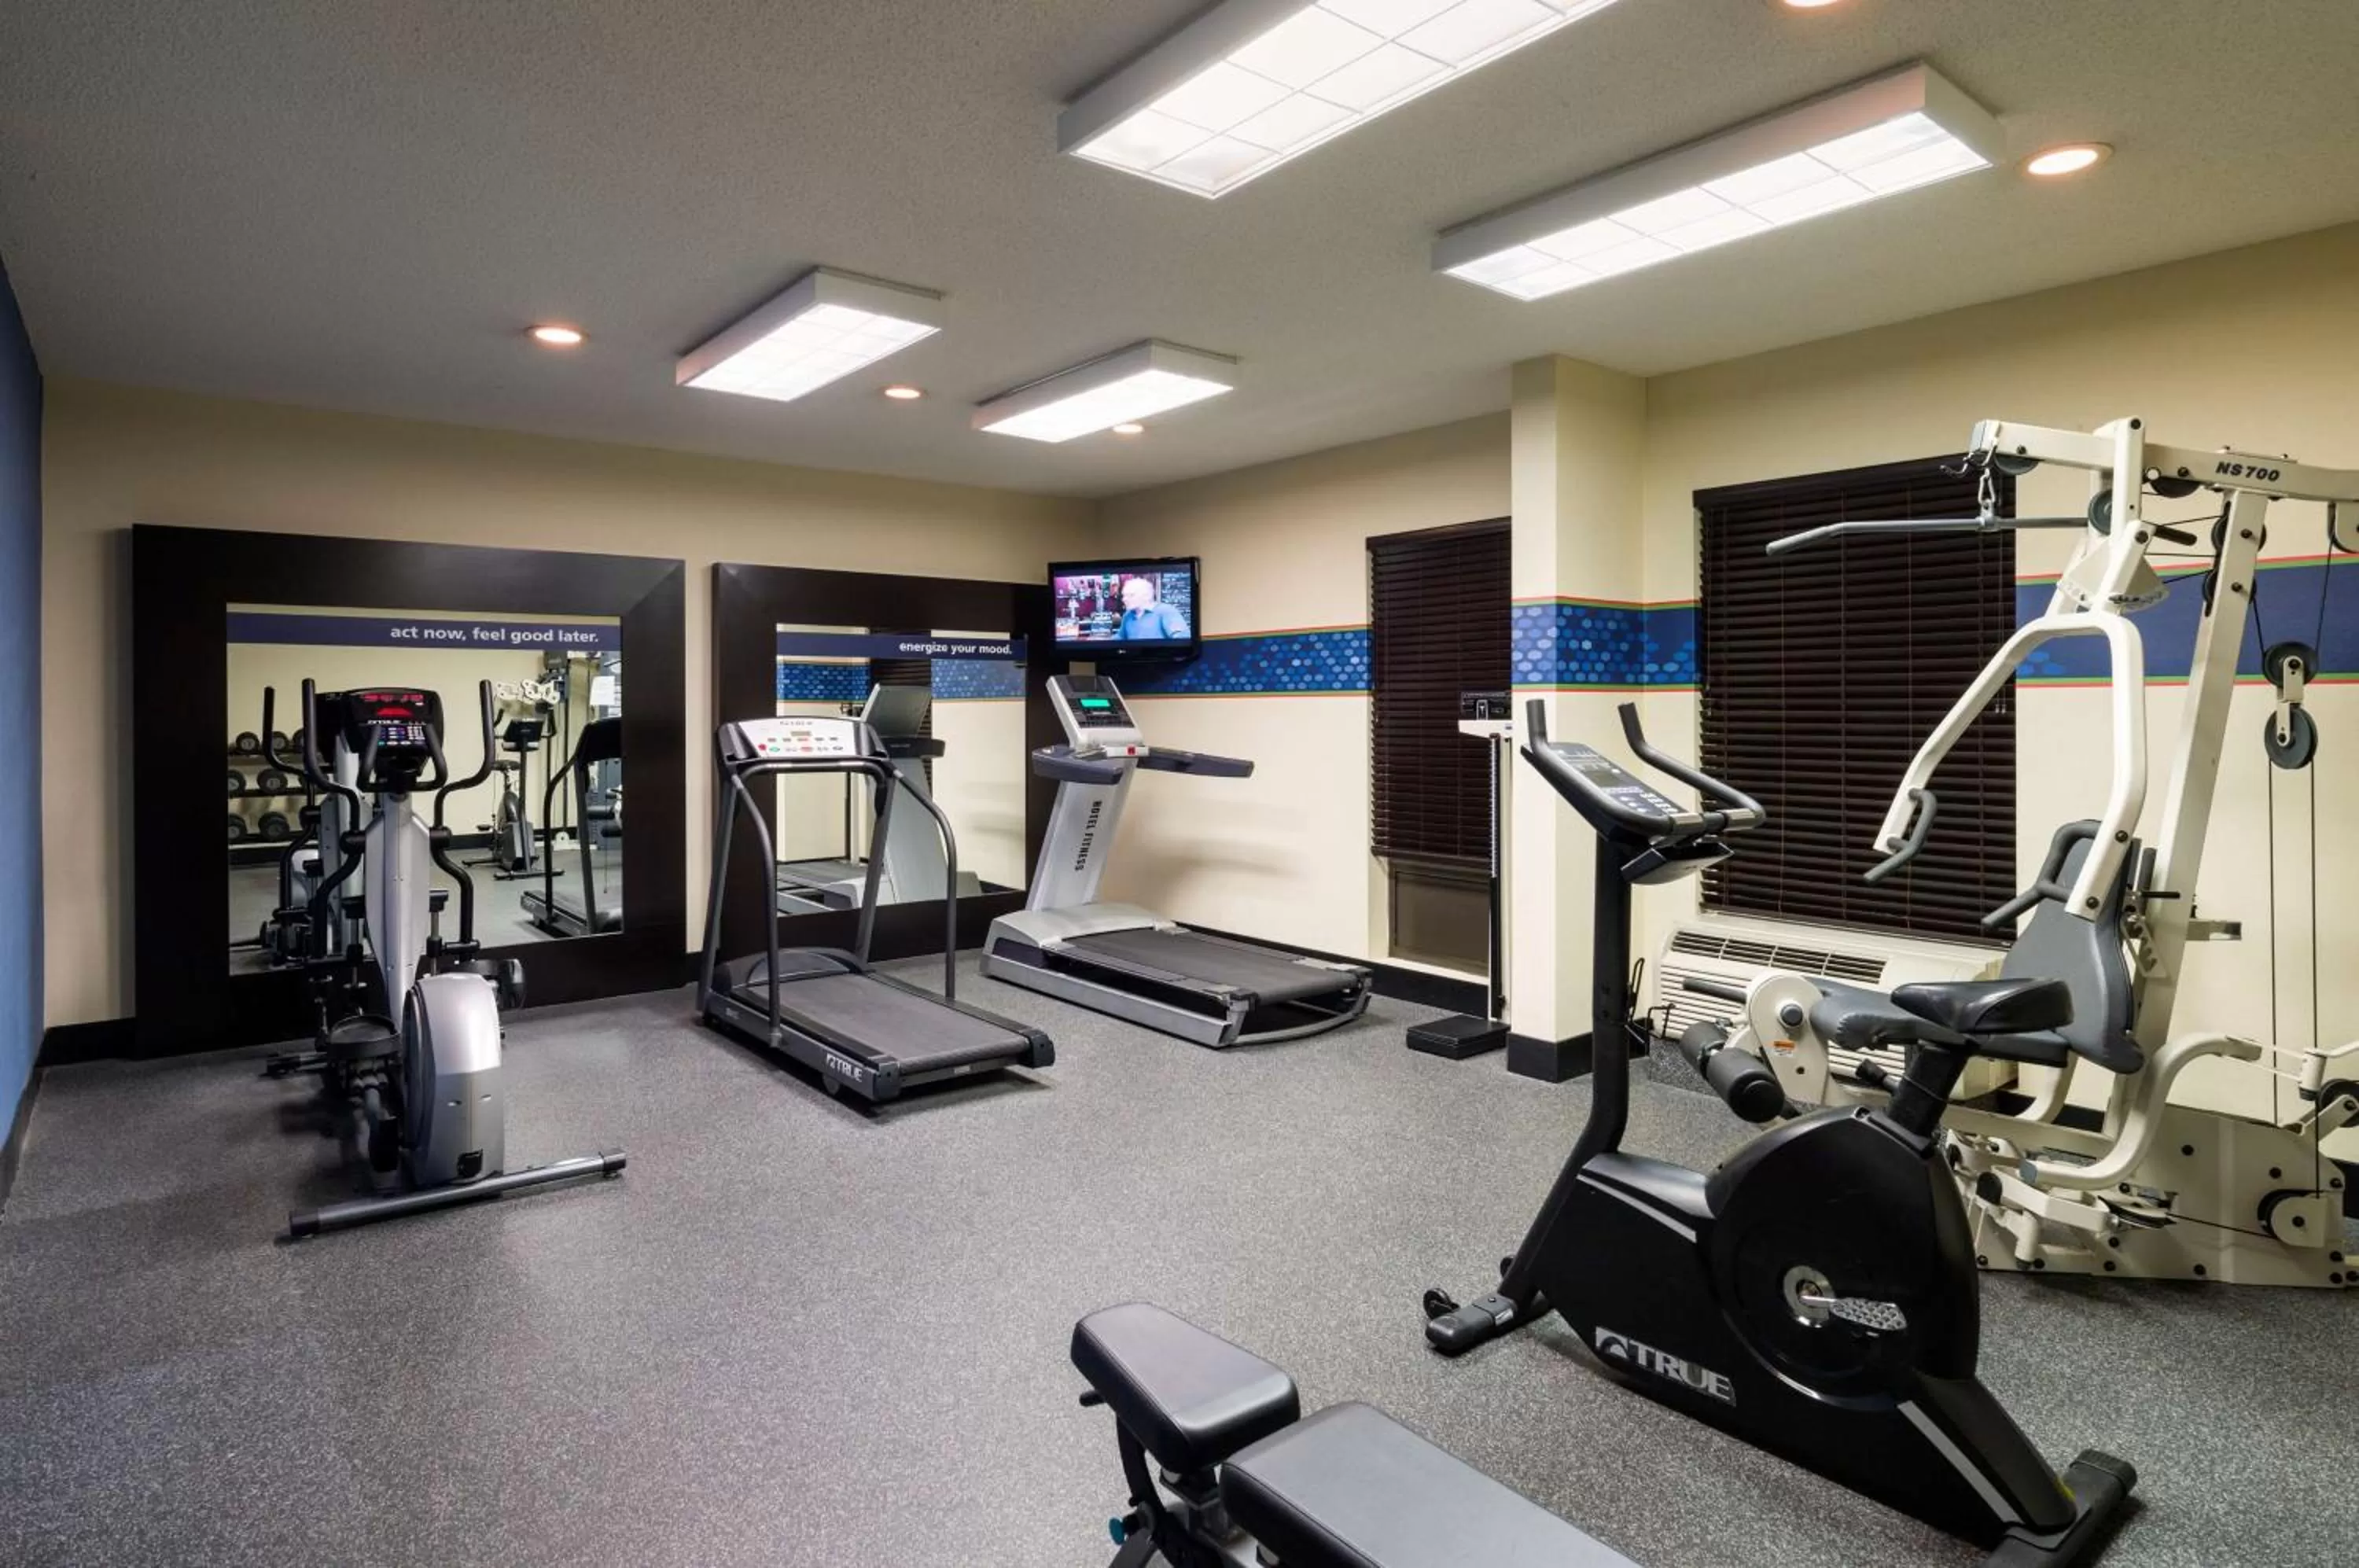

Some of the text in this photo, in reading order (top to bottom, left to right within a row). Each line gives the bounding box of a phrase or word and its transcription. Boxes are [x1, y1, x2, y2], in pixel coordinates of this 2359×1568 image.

[390, 626, 598, 644] act now, feel good later.
[899, 641, 1013, 655] energize your mood.
[1074, 801, 1102, 871] HOTEL FITNESS
[1628, 1338, 1731, 1401] TRUE
